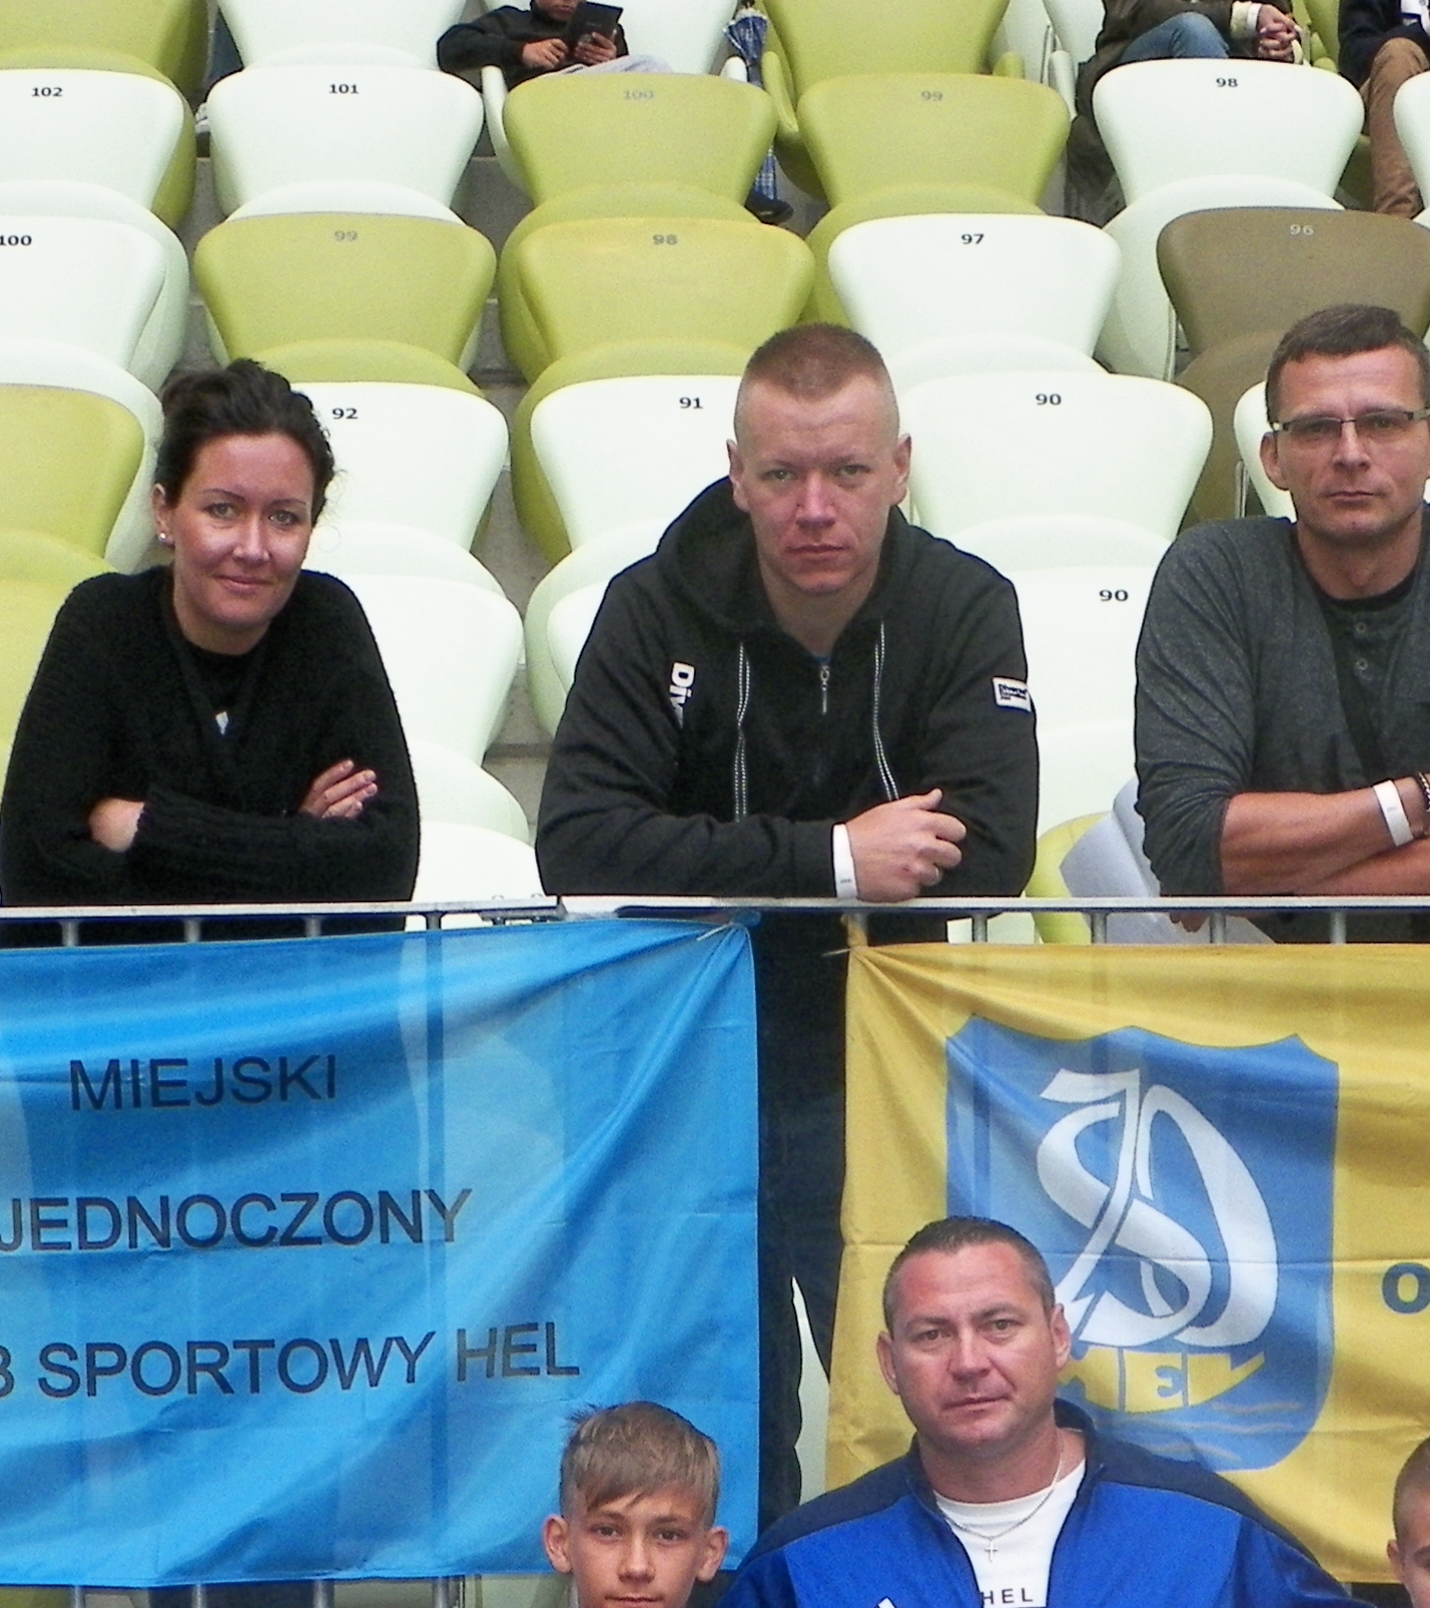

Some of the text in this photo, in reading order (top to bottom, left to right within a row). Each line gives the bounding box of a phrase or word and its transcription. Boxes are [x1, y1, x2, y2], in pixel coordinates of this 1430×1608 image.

[330, 83, 359, 95] 101
[1215, 77, 1239, 88] 98
[32, 86, 63, 98] 102
[920, 90, 944, 101] 99
[333, 229, 359, 241] 99
[1289, 223, 1315, 235] 96
[652, 233, 678, 245] 98
[960, 232, 985, 245] 97
[678, 396, 702, 410] 91
[1034, 393, 1063, 406] 90
[331, 407, 358, 420] 92
[1098, 589, 1130, 602] 90
[69, 1054, 338, 1111] MIEJSKI
[37, 1330, 437, 1398] SPORTOWY
[456, 1321, 581, 1383] HEL
[982, 1587, 1033, 1607] HEL
